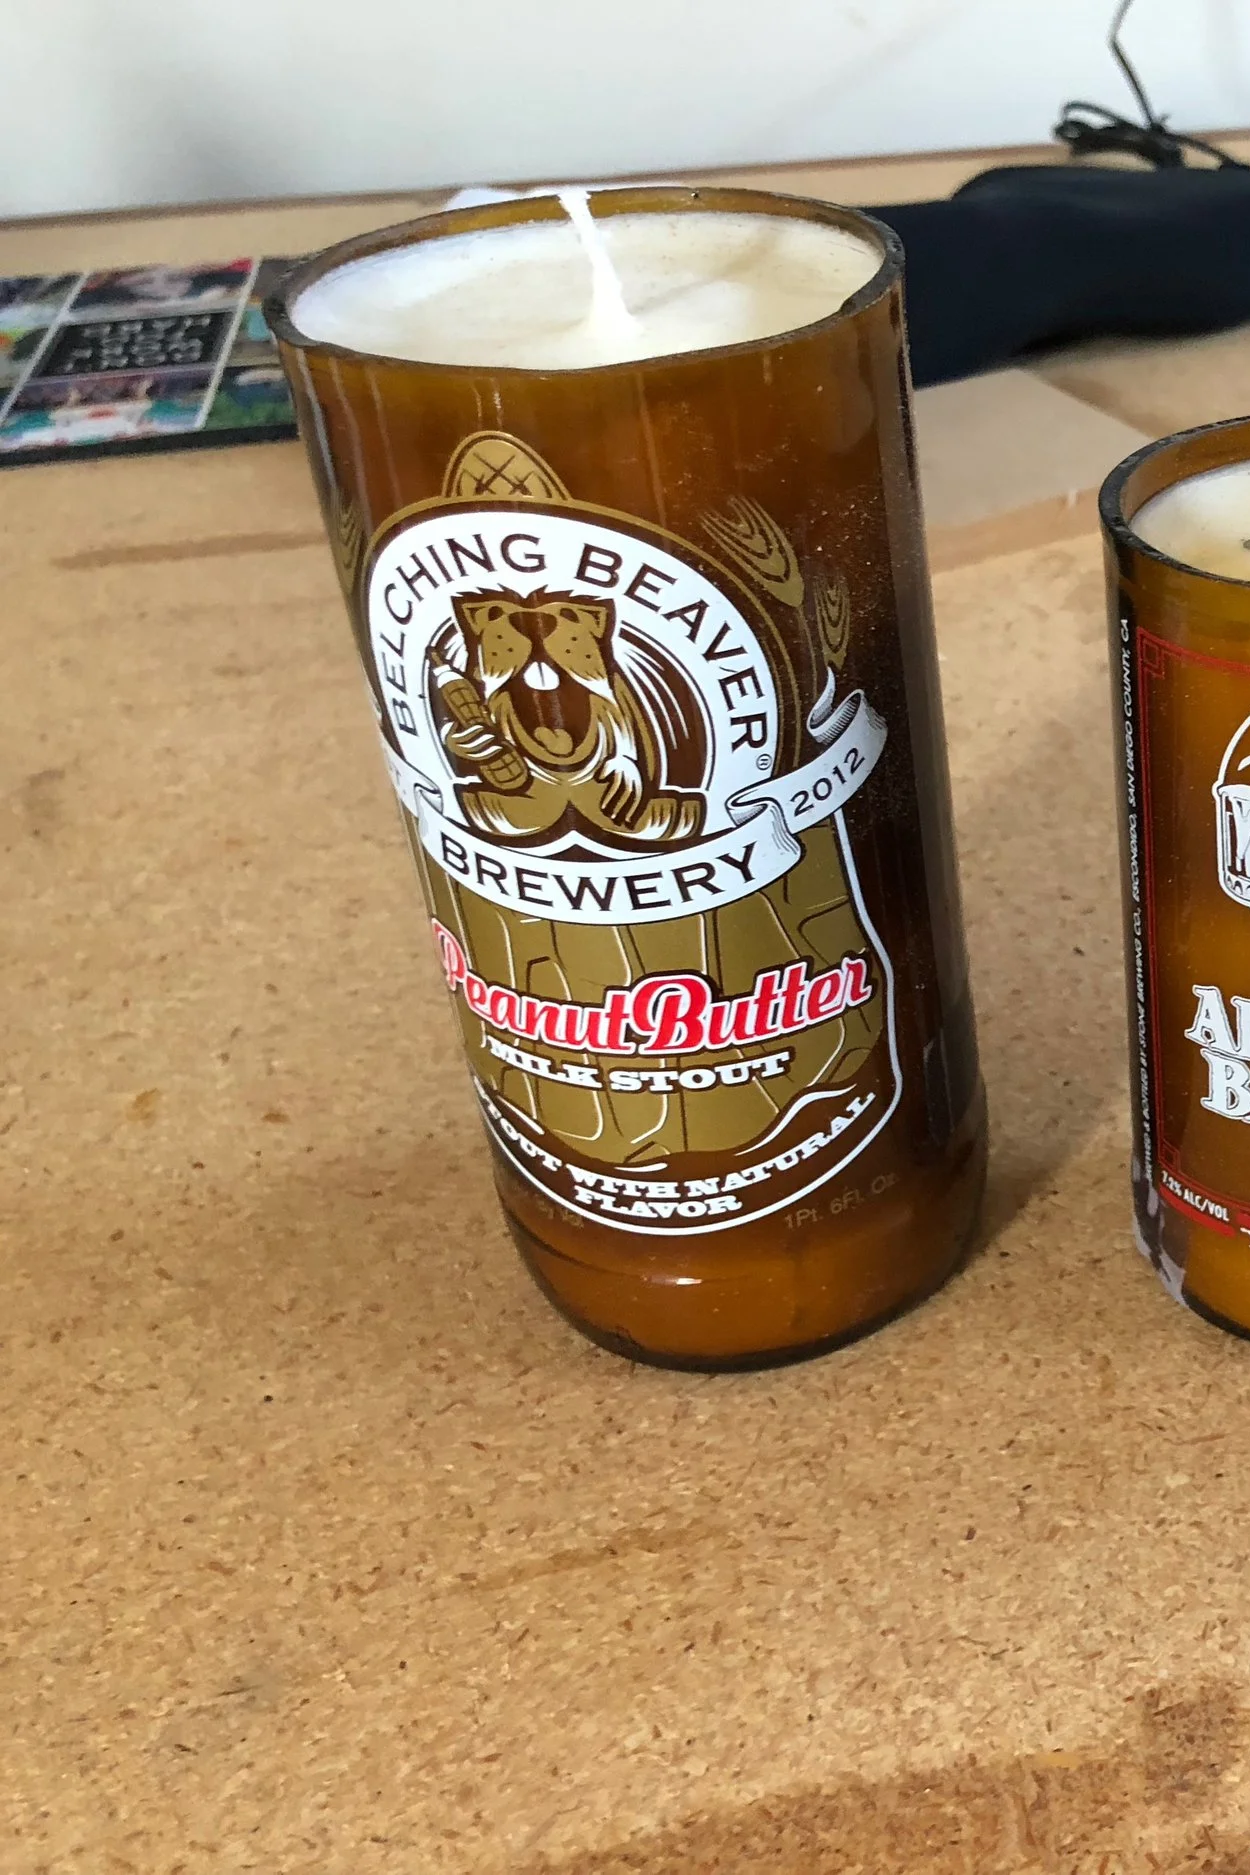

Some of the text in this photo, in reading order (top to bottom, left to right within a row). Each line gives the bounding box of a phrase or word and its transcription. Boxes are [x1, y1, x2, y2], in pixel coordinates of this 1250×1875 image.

[379, 532, 547, 737] BELCHING
[575, 542, 768, 753] BEAVER
[1121, 619, 1130, 643] CA
[1122, 647, 1132, 717] COUNTY,
[1125, 721, 1135, 771] DIEGO
[790, 747, 865, 817] 2012
[1127, 773, 1137, 807] SAN
[440, 840, 758, 912] BREWERY
[431, 917, 874, 1054] Peanut Butter
[1138, 1002, 1147, 1048] STONE
[485, 1034, 791, 1093] MILK STOUT
[565, 1162, 682, 1199] WITH
[684, 1092, 877, 1200] NATURAL
[574, 1184, 743, 1220] FLAVOR
[1183, 1188, 1230, 1222] ALC/VOL
